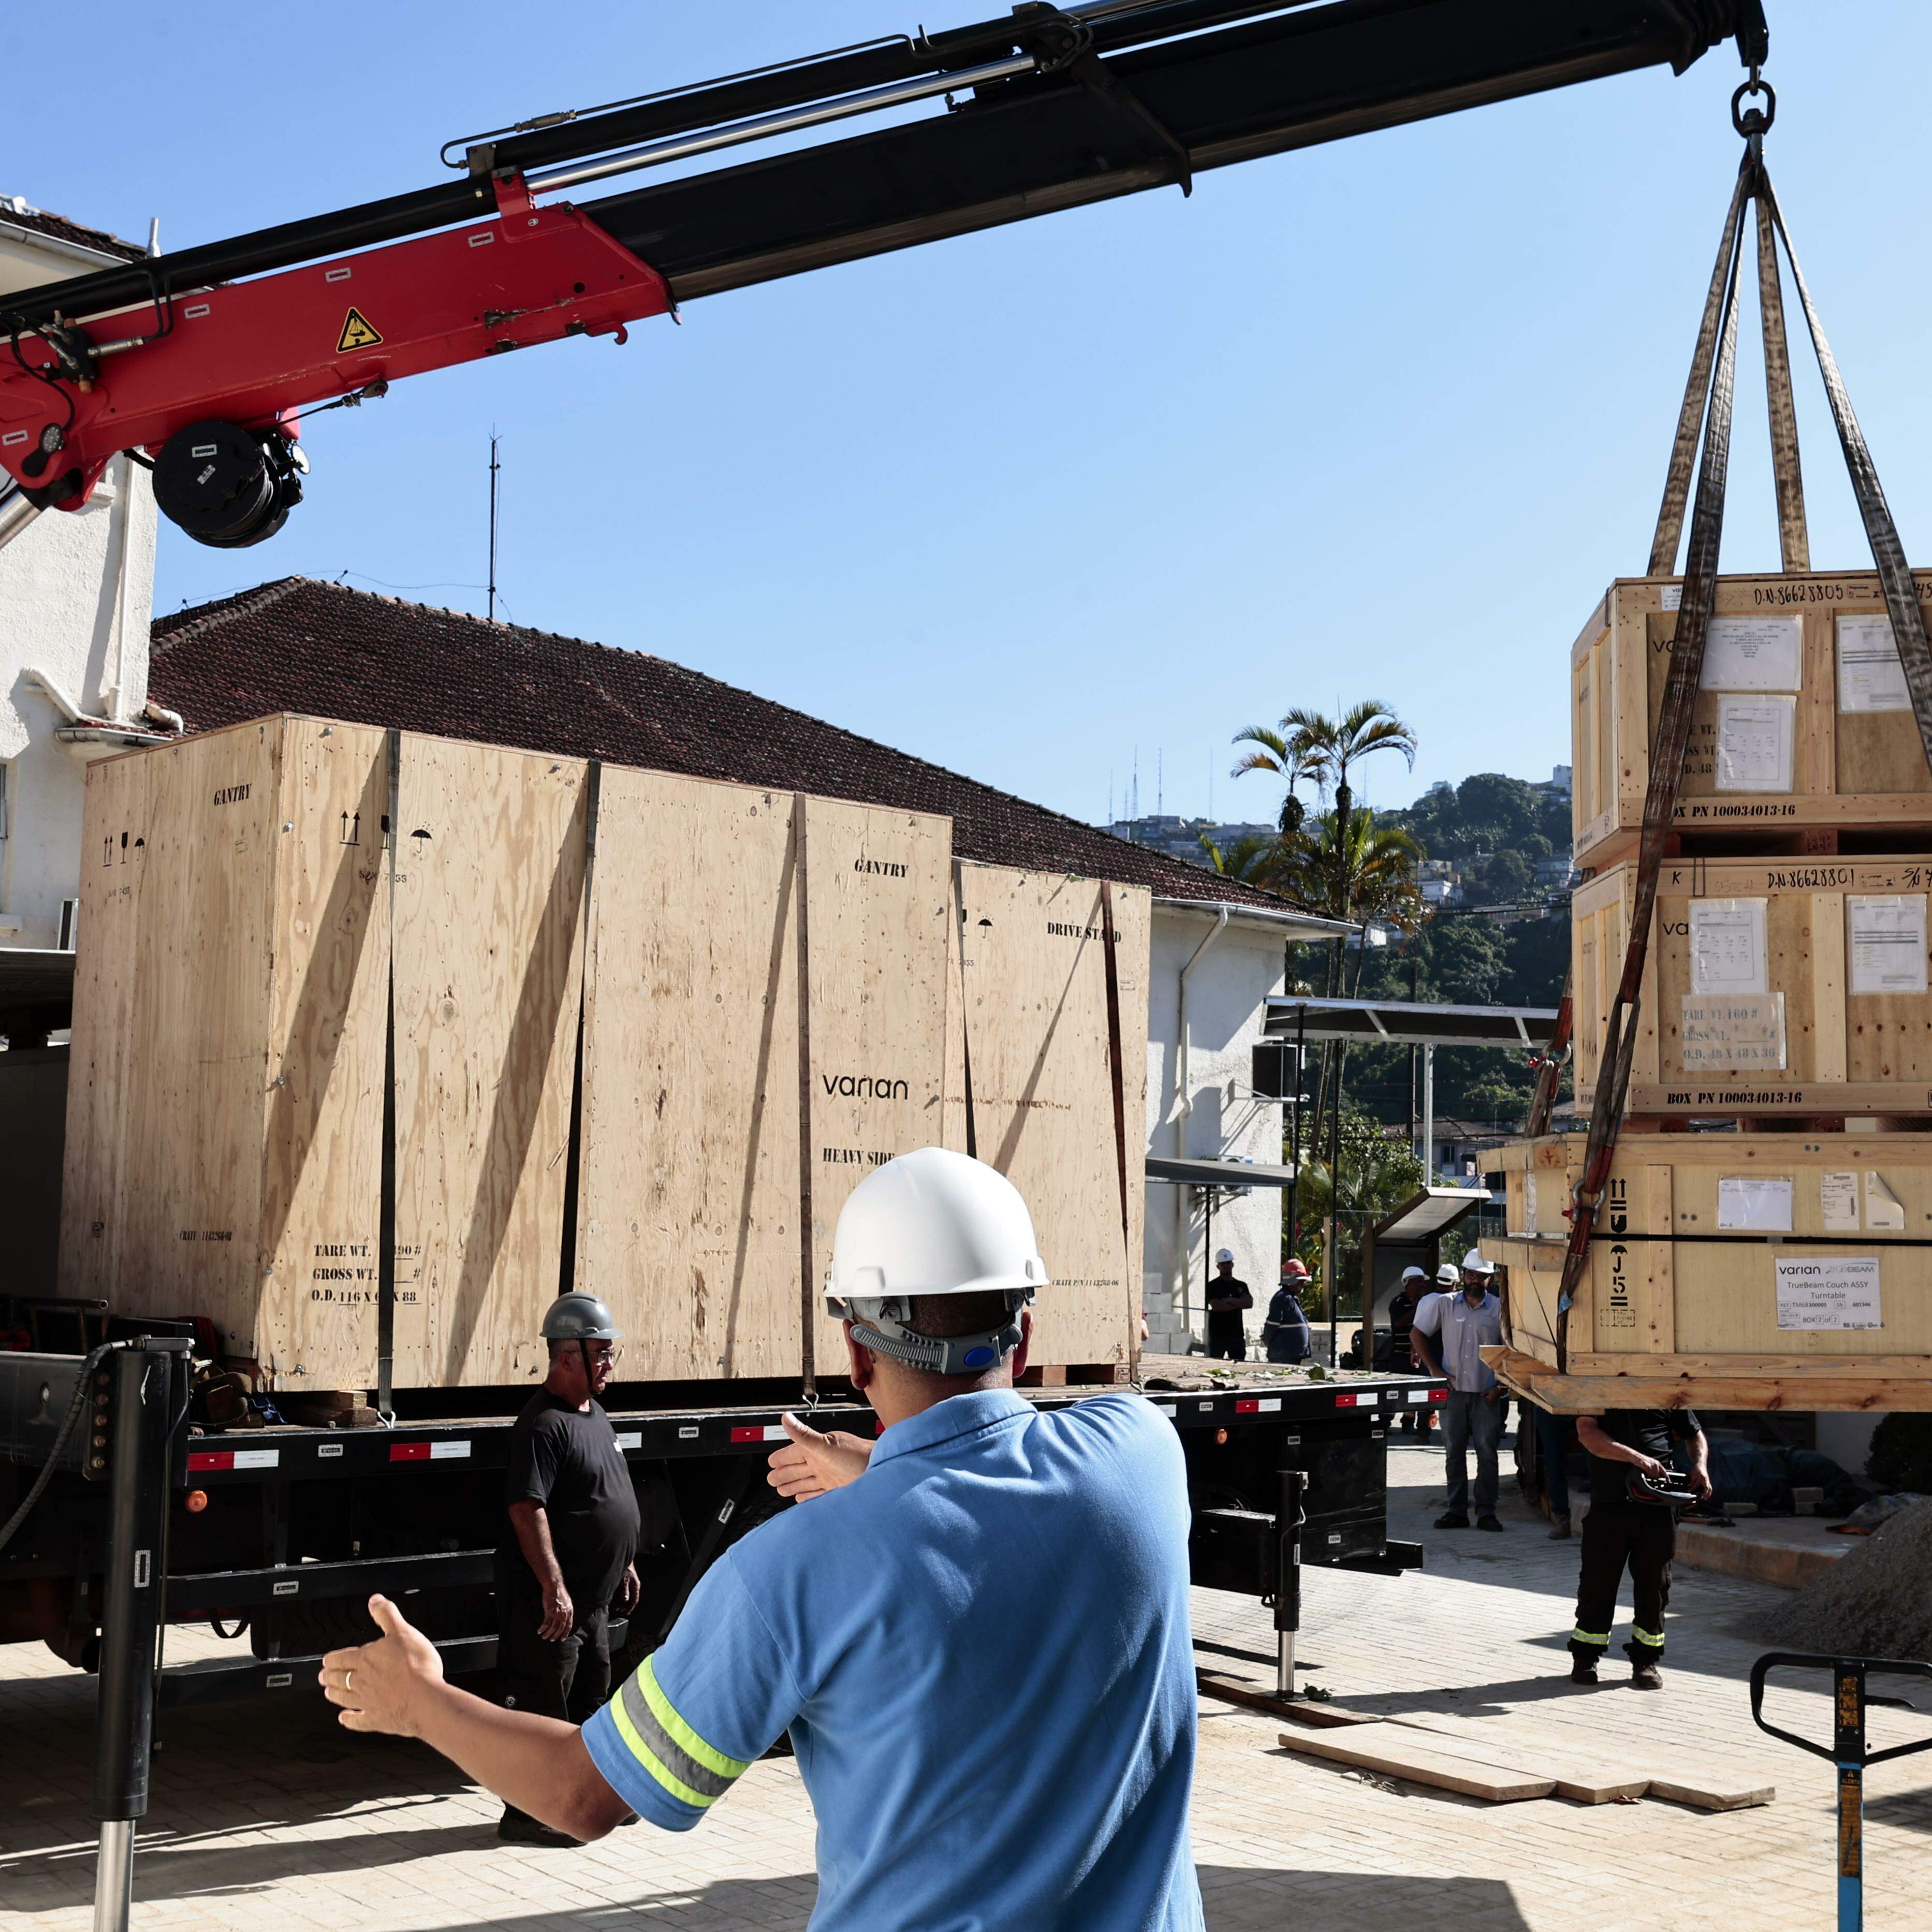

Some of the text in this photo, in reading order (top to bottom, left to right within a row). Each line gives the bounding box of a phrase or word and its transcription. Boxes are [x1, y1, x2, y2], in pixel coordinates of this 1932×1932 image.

[214, 783, 252, 806] GANTRY
[1692, 806, 1709, 817] PN
[1713, 804, 1796, 817] 100034013-16
[855, 859, 909, 879] GANTRY
[1047, 922, 1122, 943] DRIVE STAD
[823, 1075, 909, 1100] varian
[1667, 1092, 1802, 1104] BOX PN 100034013-16
[823, 1148, 864, 1164] HEAVY
[314, 1245, 346, 1256] TARE
[350, 1245, 371, 1256] WT.
[313, 1268, 353, 1280] GROSS
[356, 1268, 377, 1280] WT.
[1779, 1266, 1821, 1275] varian
[312, 1289, 336, 1301] O.D.
[403, 1292, 416, 1302] 88
